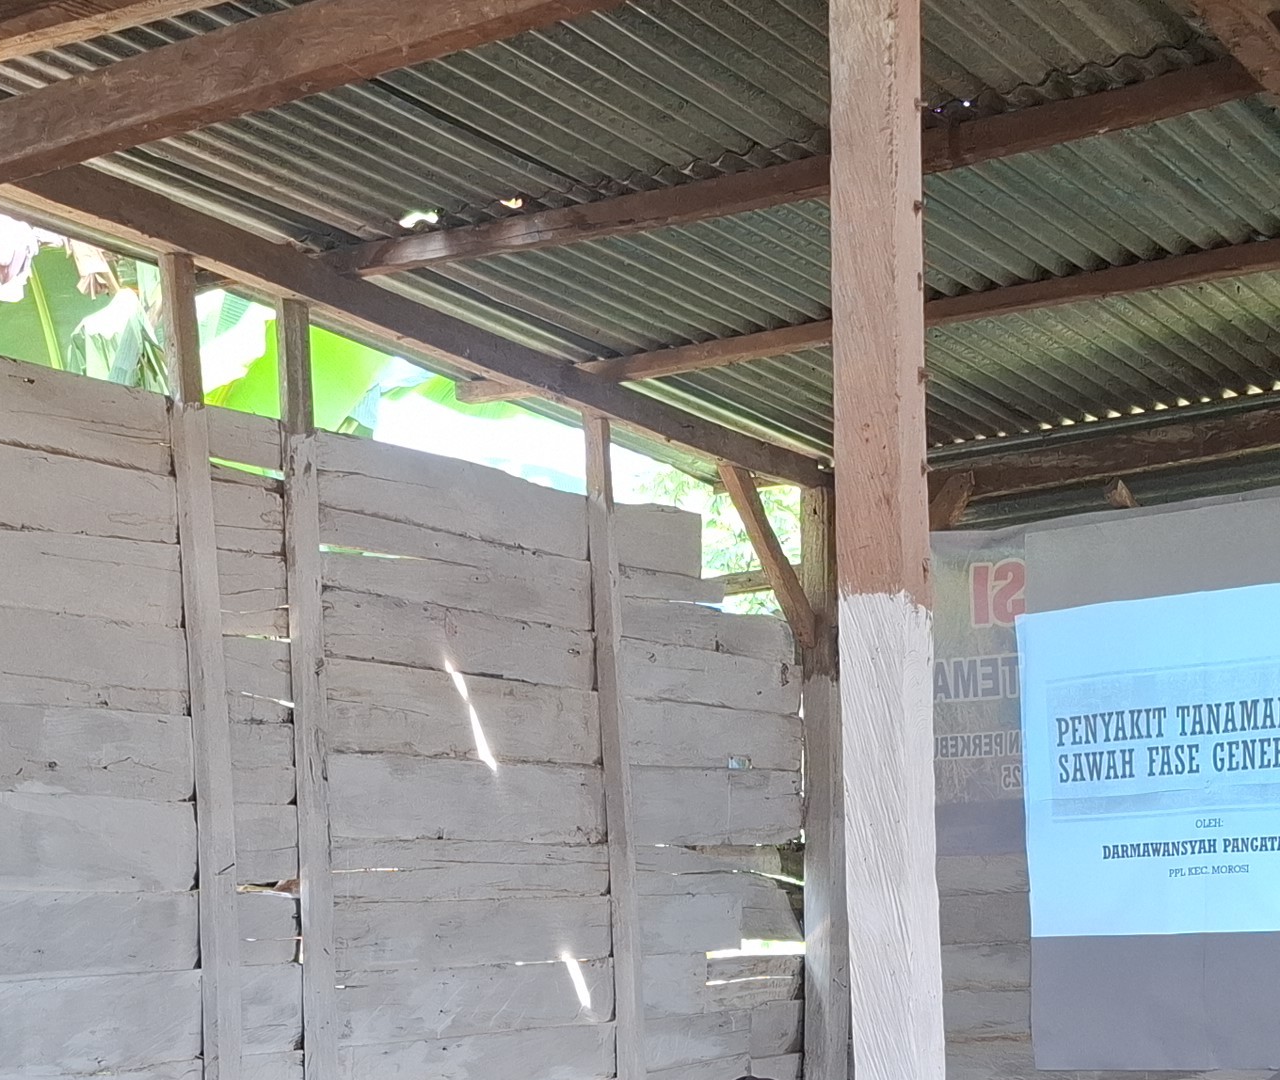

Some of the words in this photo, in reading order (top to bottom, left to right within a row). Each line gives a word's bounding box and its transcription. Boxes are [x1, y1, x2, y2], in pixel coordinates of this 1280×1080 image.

[1056, 707, 1167, 748] PENYAKIT
[1058, 748, 1136, 784] SAWAH
[1147, 744, 1201, 777] FASE
[1195, 818, 1224, 830] OLEH:
[1102, 839, 1217, 860] DARMAWANSYAH
[1169, 867, 1186, 878] PPL
[1188, 866, 1210, 877] KEC.
[1211, 864, 1250, 875] MOROSI
